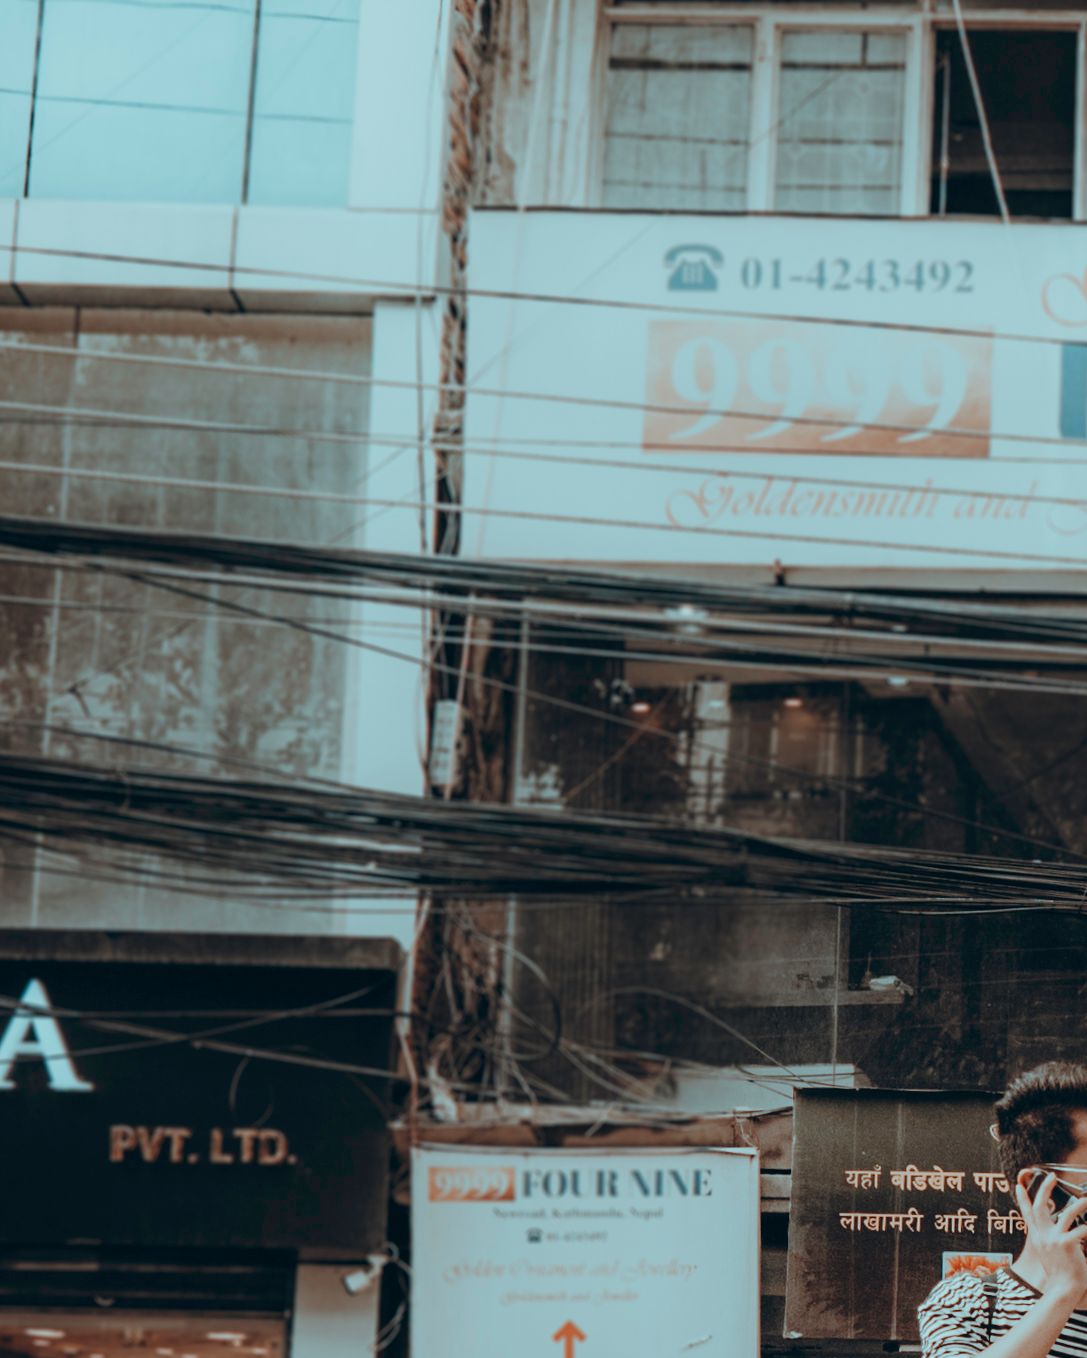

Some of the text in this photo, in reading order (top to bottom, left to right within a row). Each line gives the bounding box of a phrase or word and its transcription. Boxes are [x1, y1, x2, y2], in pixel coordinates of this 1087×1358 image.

[740, 257, 976, 294] 01-4243492
[667, 335, 968, 444] 9999
[953, 480, 1039, 521] and
[0, 977, 94, 1092] A
[109, 1124, 298, 1164] PVT. LTD.
[522, 1168, 713, 1198] FOUR NINE
[845, 1164, 881, 1190] यहाँ
[890, 1165, 965, 1192] बडिखेल
[840, 1207, 923, 1233] लाखामरी
[935, 1208, 977, 1234] आदि
